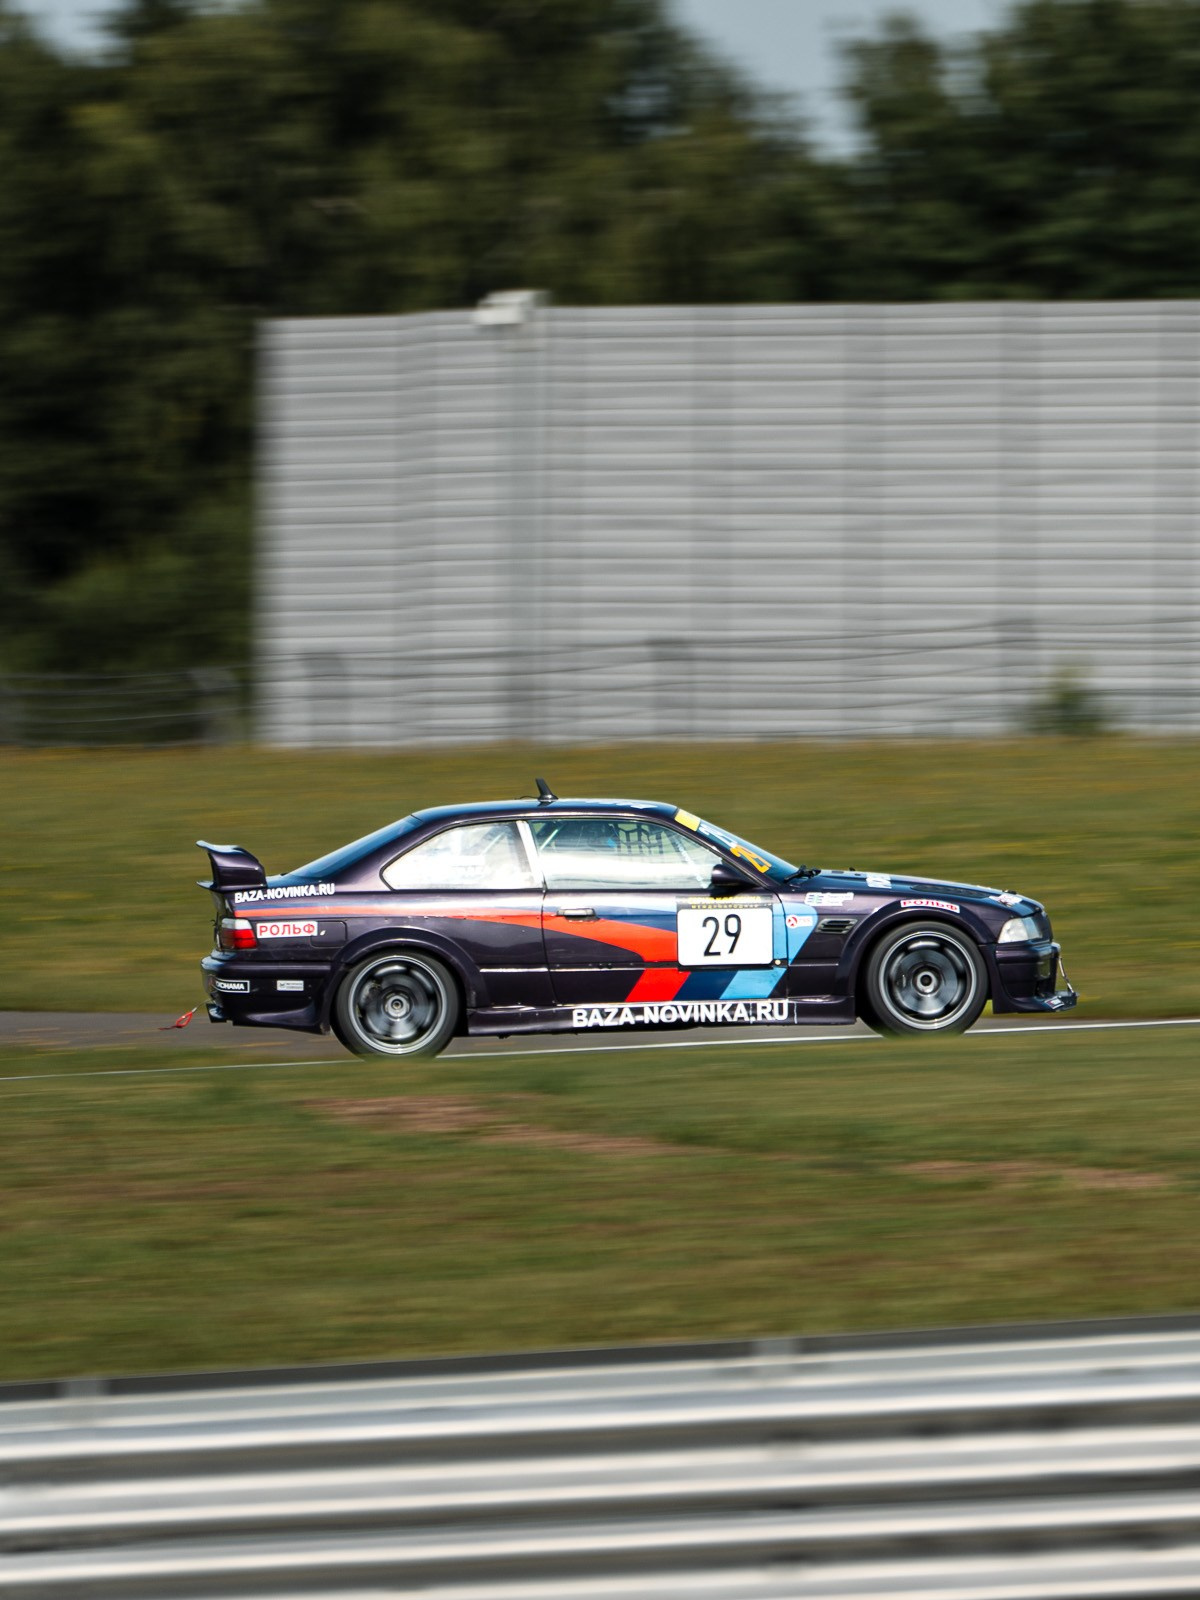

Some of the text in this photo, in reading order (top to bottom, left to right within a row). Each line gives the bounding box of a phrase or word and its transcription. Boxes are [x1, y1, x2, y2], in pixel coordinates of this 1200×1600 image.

[234, 883, 336, 904] BAZA-NOVINKA.RU
[903, 900, 958, 911] РОЛЬФ
[259, 923, 315, 937] РОЛЬФ
[701, 914, 742, 957] 29
[572, 998, 789, 1028] BAZA-NOVINKA.RU
